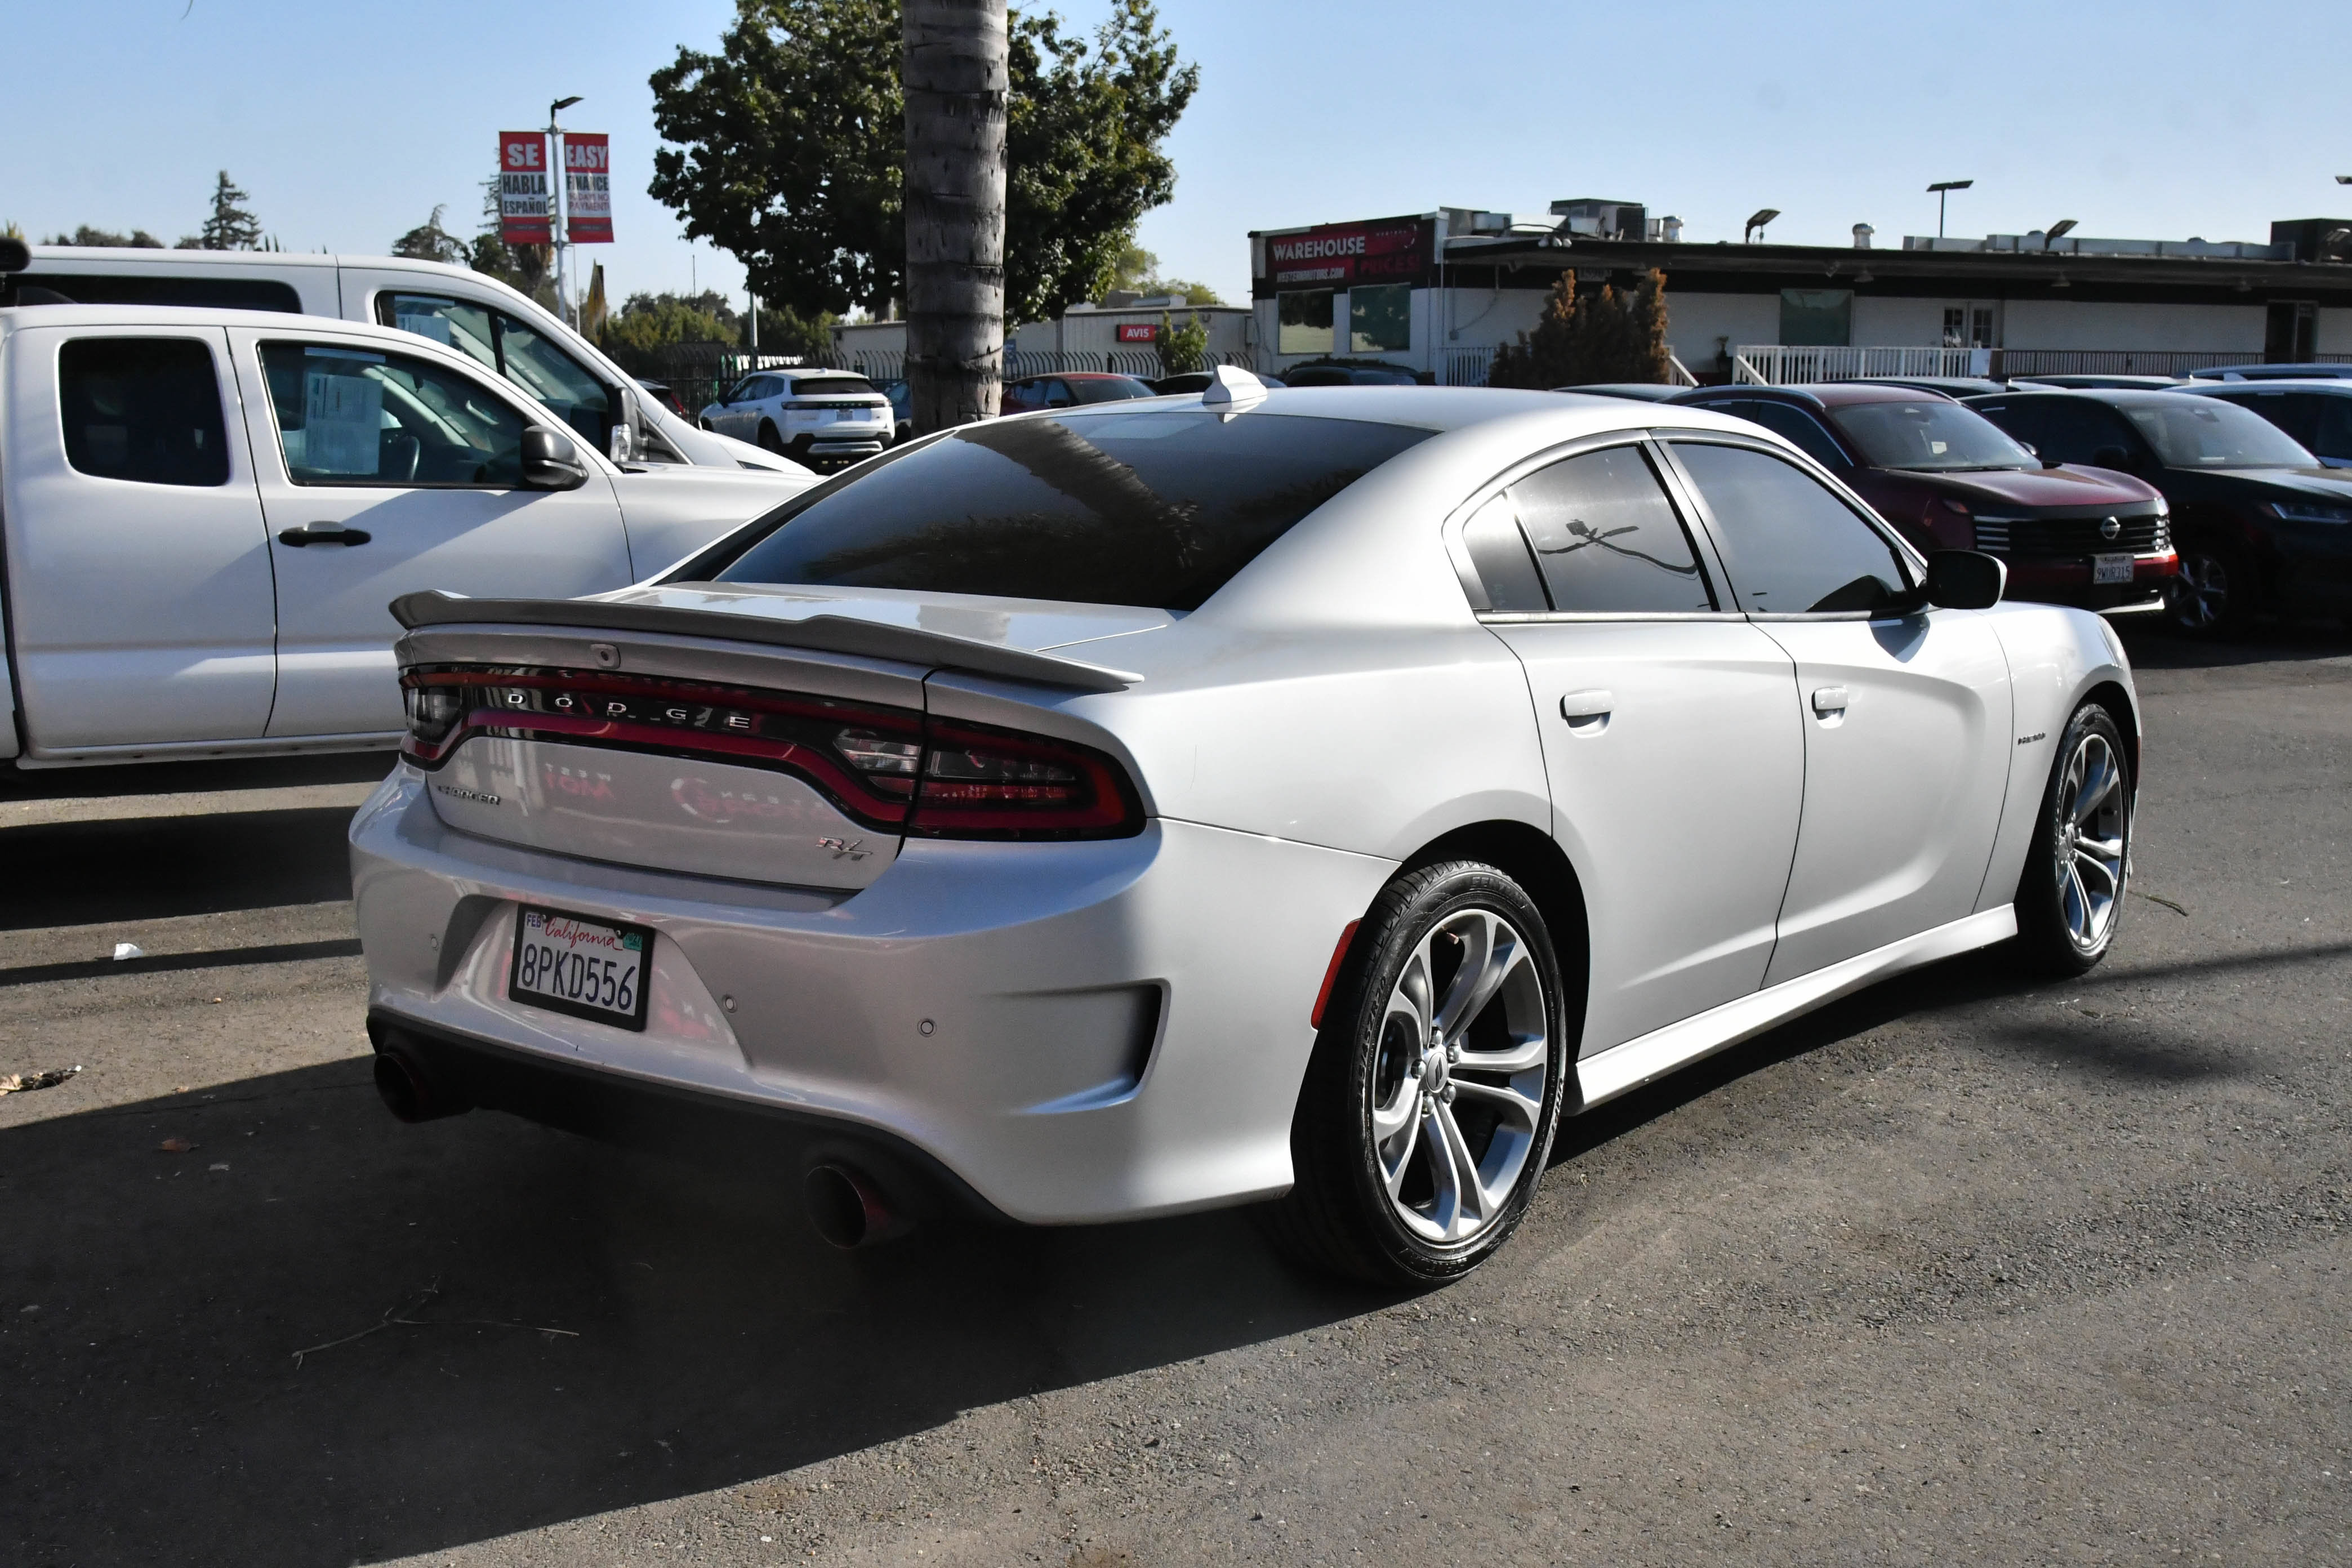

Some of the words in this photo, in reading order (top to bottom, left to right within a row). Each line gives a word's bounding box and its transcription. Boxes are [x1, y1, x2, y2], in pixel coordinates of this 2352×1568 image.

[507, 143, 539, 167] SE
[565, 145, 608, 168] EASY
[502, 175, 546, 195] HABLA
[504, 197, 547, 215] ESPAÑOL
[1273, 237, 1366, 261] WAREHOUSE
[1126, 328, 1149, 338] AVIS
[508, 693, 750, 728] DODGE
[815, 836, 874, 861] R/T
[527, 913, 541, 928] FEB
[545, 916, 623, 951] California
[522, 943, 636, 1010] 8PKD556
